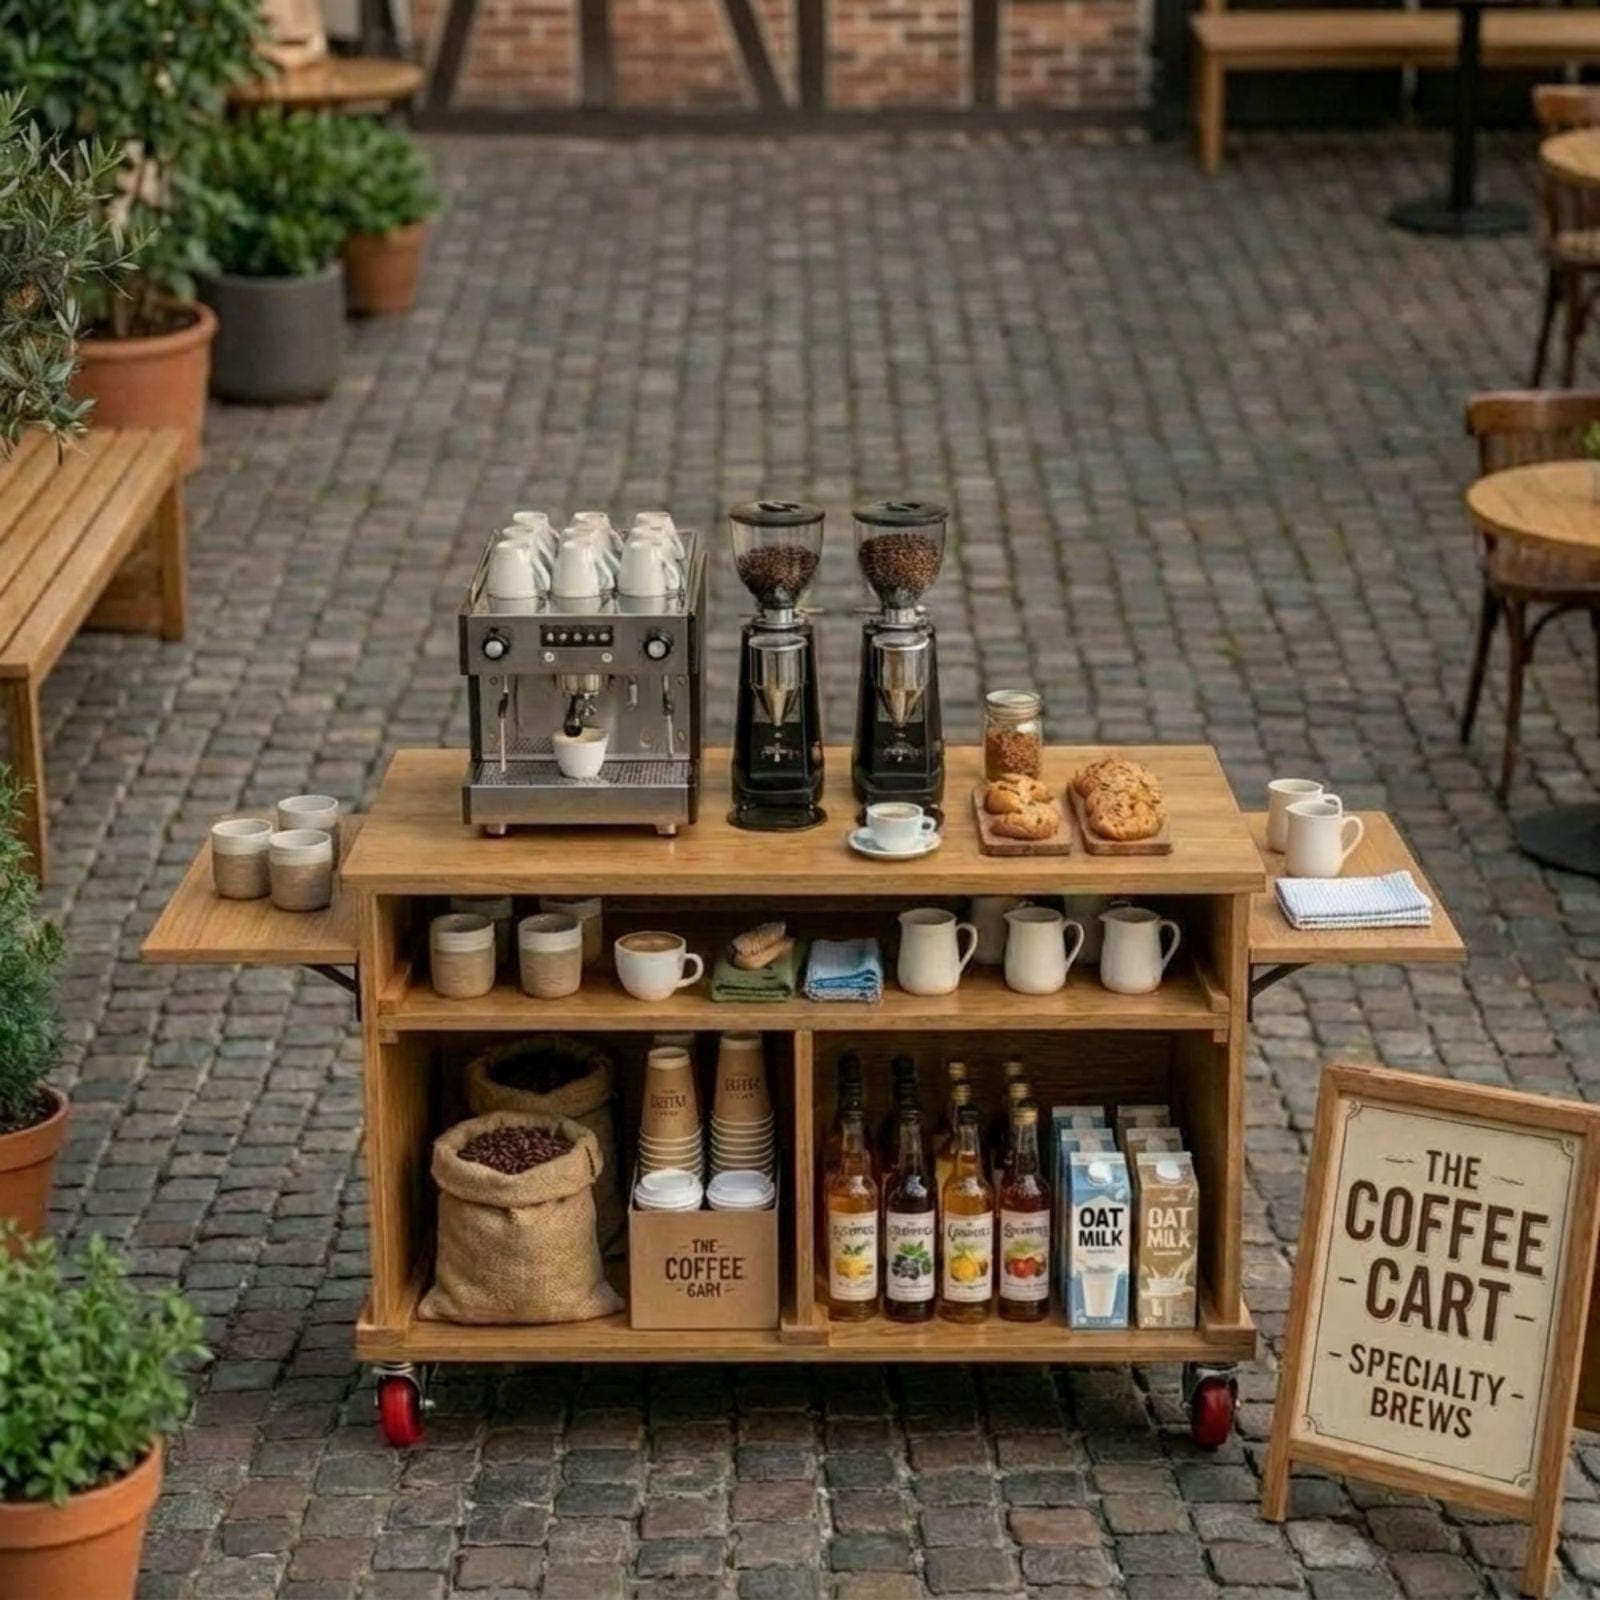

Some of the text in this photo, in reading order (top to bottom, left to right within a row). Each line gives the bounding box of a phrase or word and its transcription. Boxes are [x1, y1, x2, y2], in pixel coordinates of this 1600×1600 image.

[1426, 1149, 1482, 1190] THE
[1078, 1230, 1122, 1247] MILK
[1079, 1207, 1124, 1228] OAT
[1345, 1179, 1549, 1276] COFFEE
[665, 1257, 744, 1280] COFFEE
[1365, 1257, 1511, 1341] CART
[1348, 1343, 1505, 1406] SPECIALTY
[1370, 1388, 1473, 1438] BREWS
